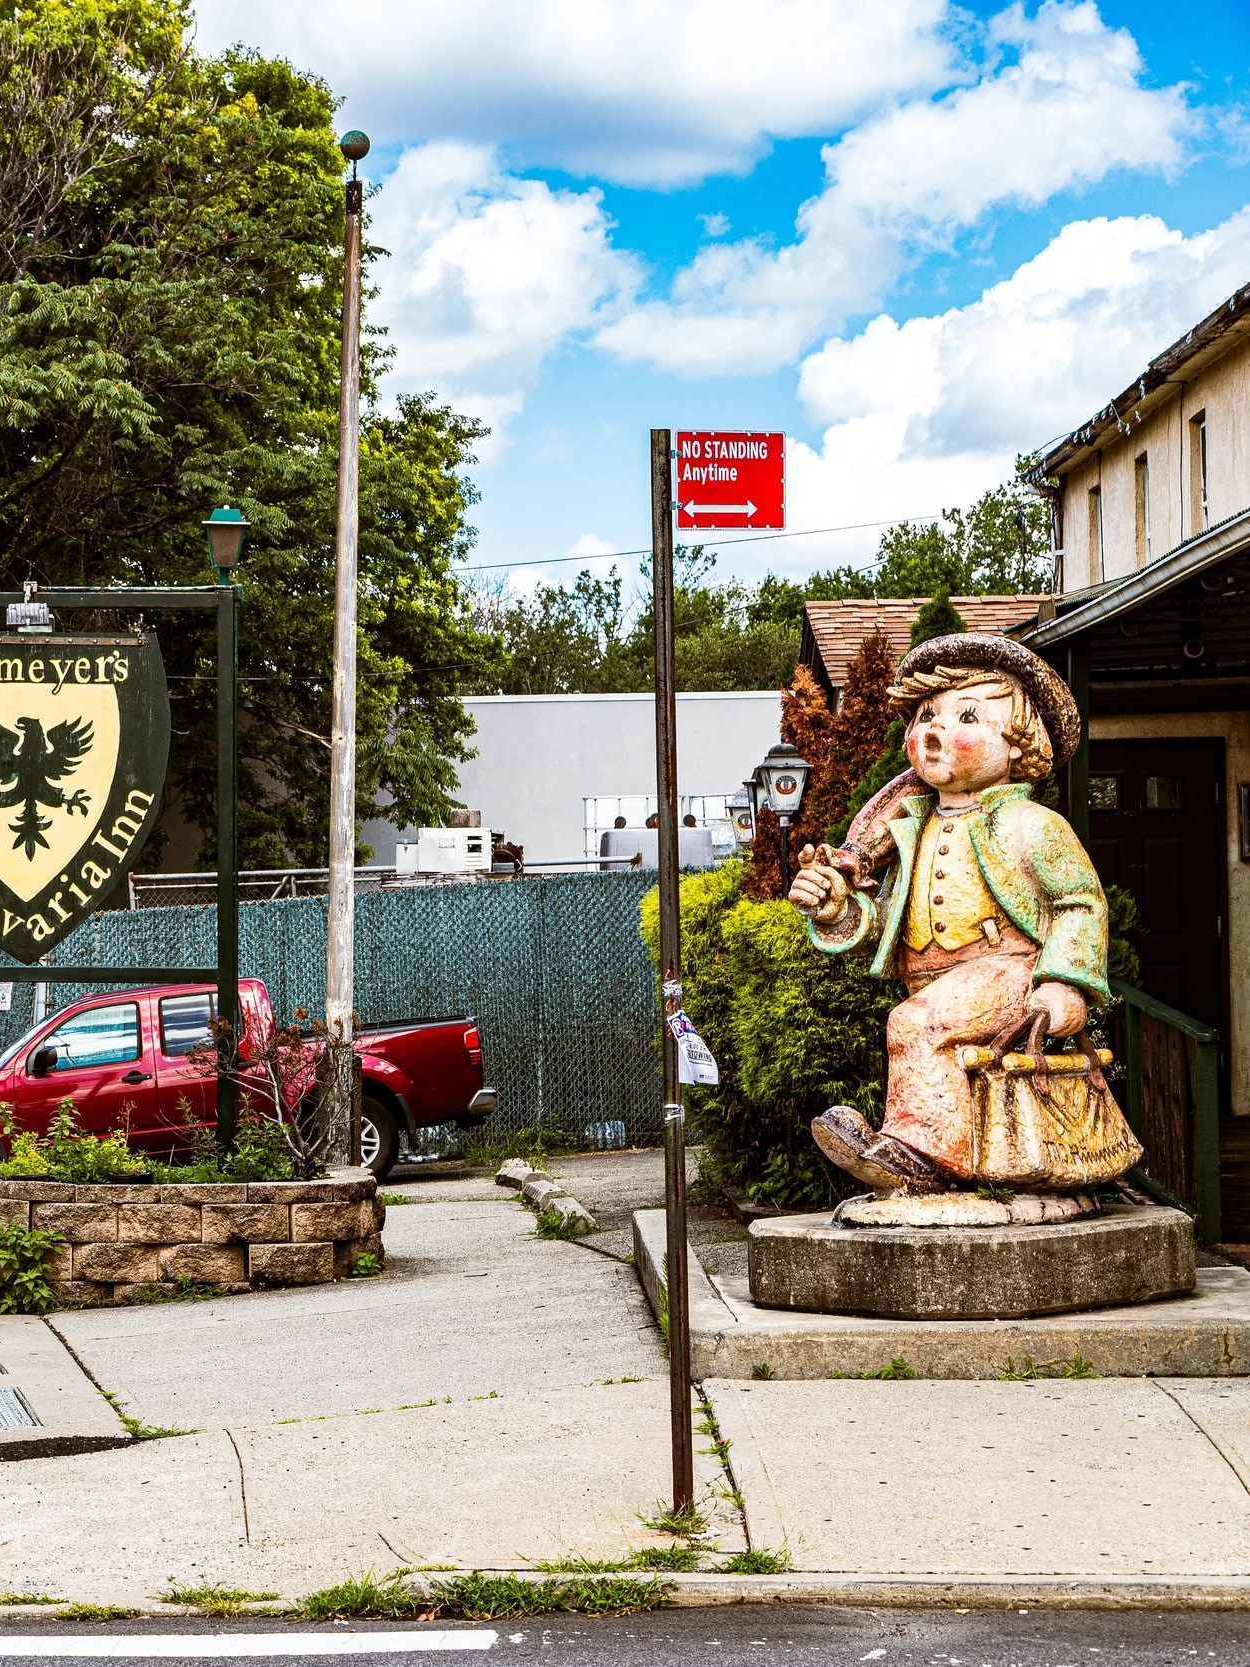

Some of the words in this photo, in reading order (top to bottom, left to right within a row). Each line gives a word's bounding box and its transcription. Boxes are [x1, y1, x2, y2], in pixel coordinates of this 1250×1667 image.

[682, 440, 701, 459] NO
[704, 441, 768, 460] STANDING
[683, 463, 738, 485] Anytime
[91, 788, 156, 865] Inn
